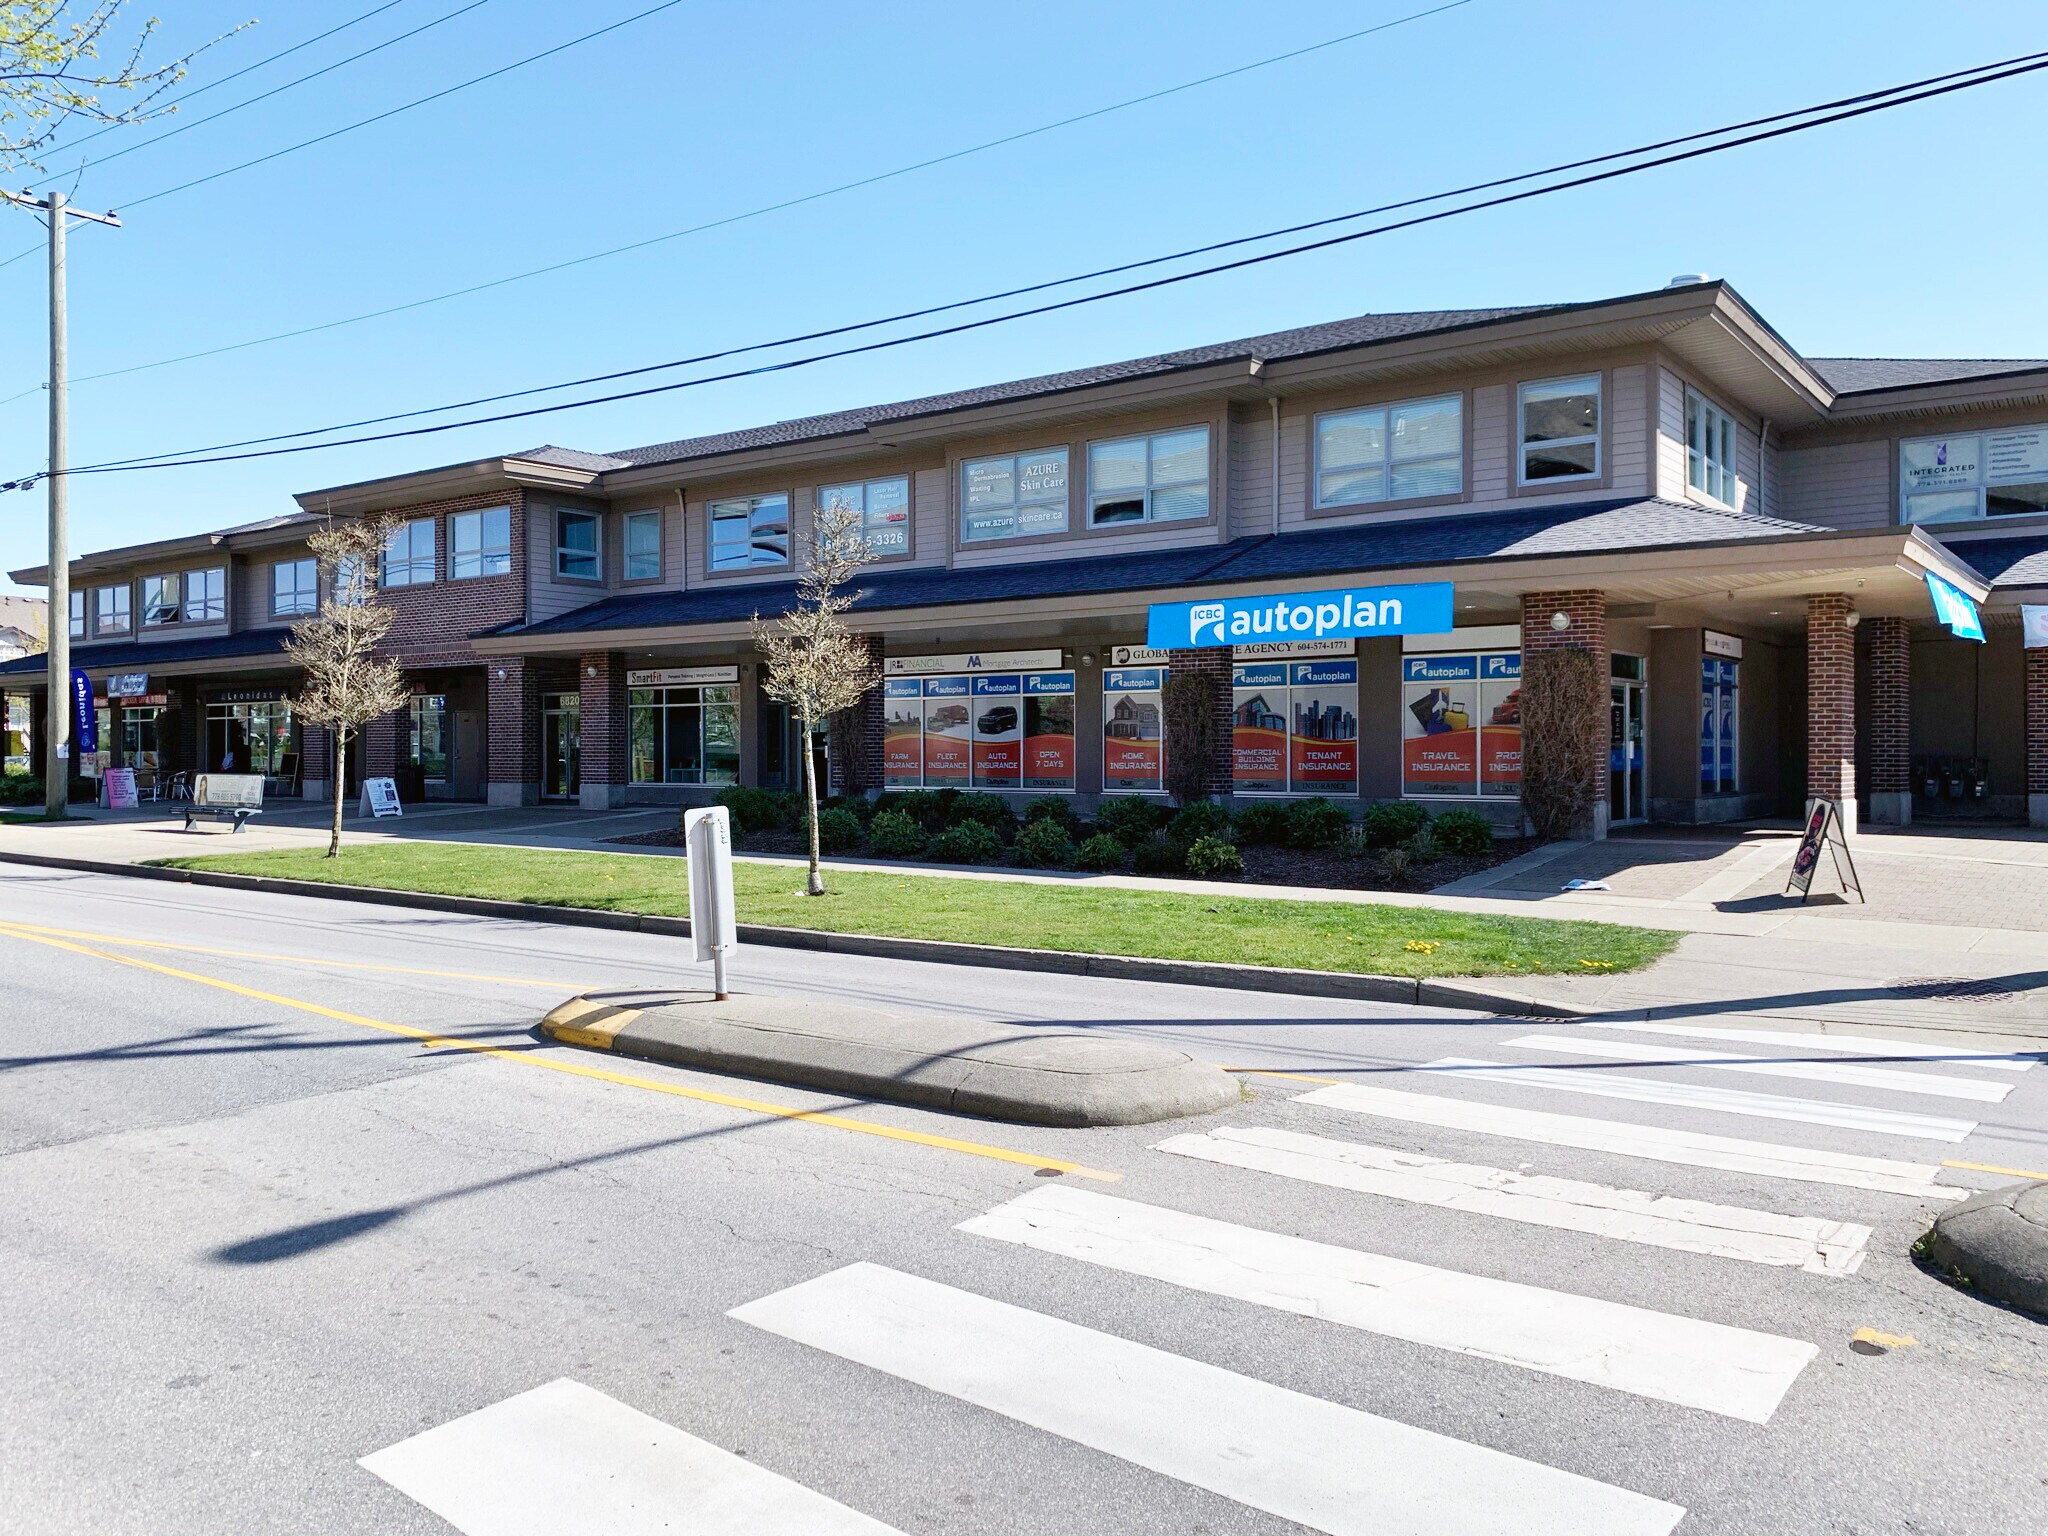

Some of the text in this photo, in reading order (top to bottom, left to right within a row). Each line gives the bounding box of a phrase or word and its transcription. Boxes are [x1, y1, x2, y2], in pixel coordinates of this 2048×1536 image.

[1025, 462, 1059, 477] AZURE
[1909, 463, 1975, 477] INTEGRATED
[974, 472, 1010, 482] Dermabrasion
[1020, 477, 1064, 491] Skin Care
[970, 485, 991, 493] Waxing
[1018, 511, 1063, 524] skincare.ca
[1193, 594, 1402, 637] ICBC autoplan
[1297, 641, 1348, 651] 604-574-1771
[1133, 649, 1169, 660] GLOBA
[1244, 642, 1293, 654] AGENCY
[903, 658, 945, 669] FINANCIAL
[983, 659, 1011, 668] Mortgage
[631, 671, 663, 684] SmartFit
[1312, 671, 1351, 682] autoplan
[1427, 667, 1470, 679] autoplan
[1123, 679, 1155, 688] autoplan
[1245, 674, 1282, 684] autoplan
[938, 685, 966, 695] autoplan
[987, 683, 1017, 693] autoplan
[1040, 681, 1071, 691] autoplan
[227, 691, 273, 700] Leonidas
[892, 686, 918, 696] autoplan
[560, 695, 580, 706] 6820
[988, 752, 1007, 760] AUTO
[1039, 751, 1060, 759] OPEN
[1121, 752, 1145, 760] HOME
[1232, 748, 1282, 756] COMMERCIAL
[1307, 751, 1342, 760] TENANT
[1421, 752, 1461, 760] TRAVEL
[884, 761, 919, 769] NSURANCE
[928, 761, 967, 769] INSURANCE
[977, 761, 1018, 769] INSURANCE
[1044, 760, 1064, 768] DAYS
[1110, 762, 1157, 770] INSURANCE
[1234, 763, 1279, 771] INSURANCE
[1298, 762, 1352, 771] INSURANCE
[1411, 763, 1471, 772] INSURANCE
[1488, 763, 1522, 772] INSUR
[1302, 782, 1347, 790] INSURANCE
